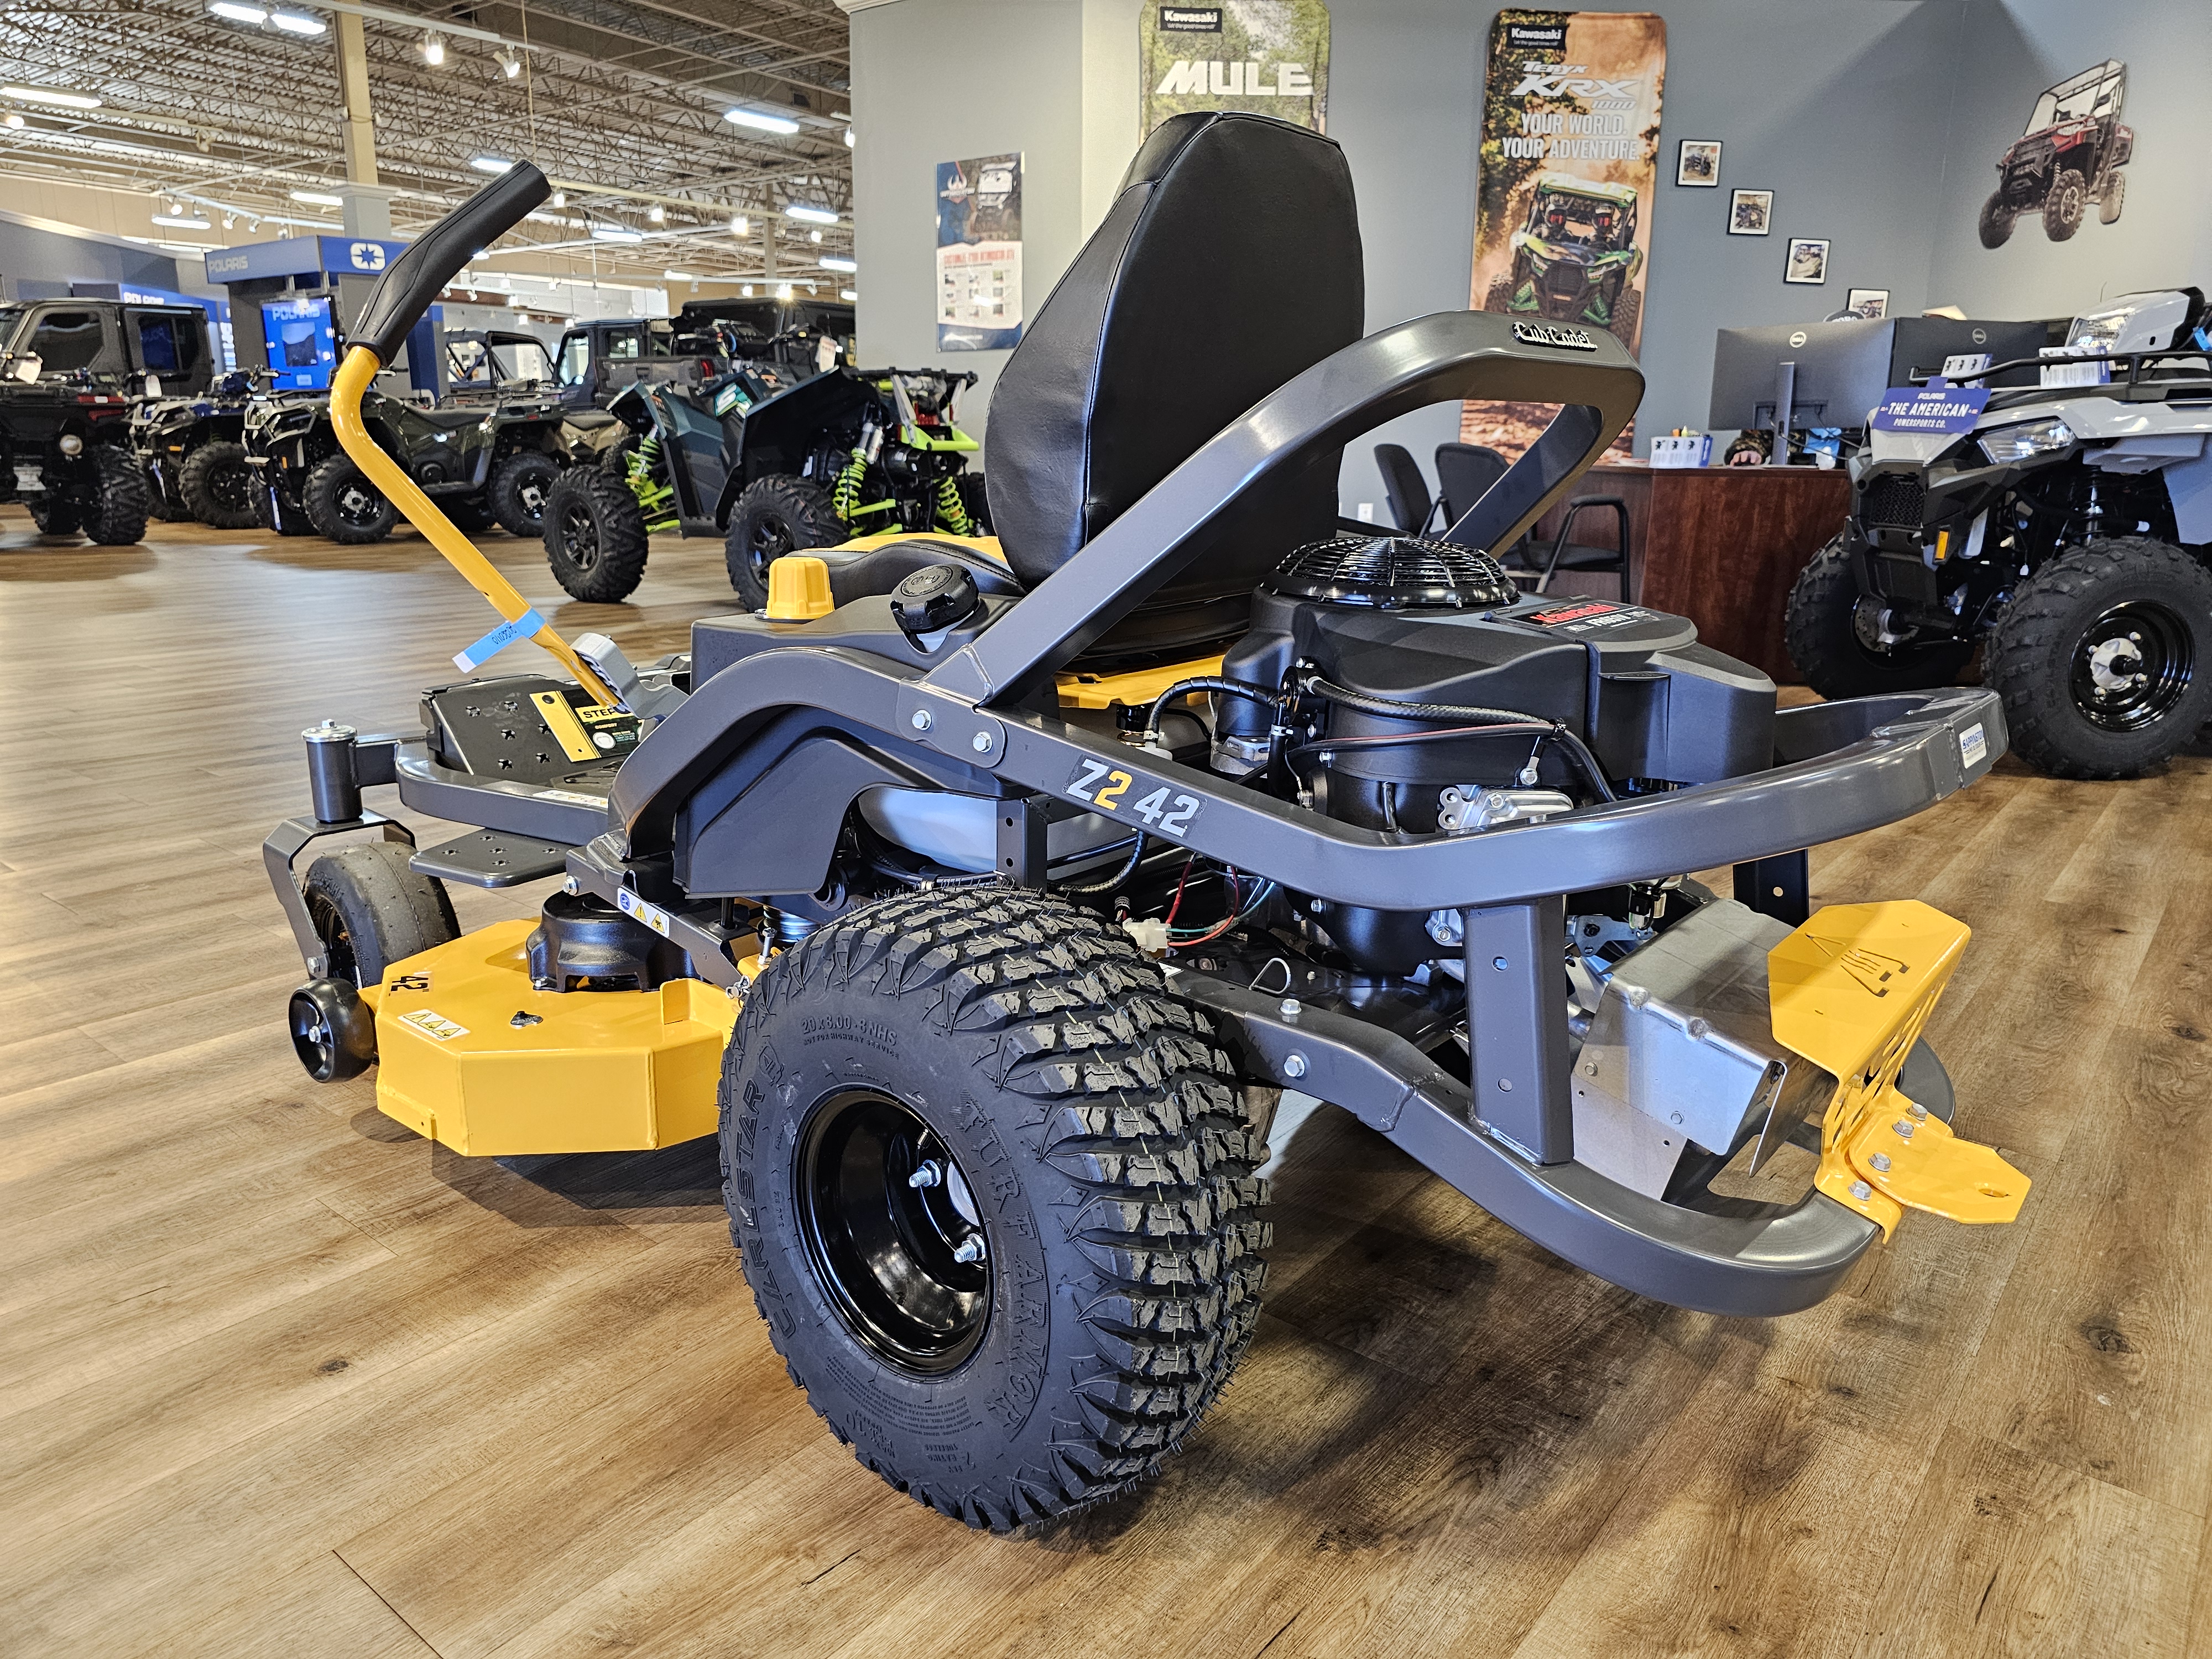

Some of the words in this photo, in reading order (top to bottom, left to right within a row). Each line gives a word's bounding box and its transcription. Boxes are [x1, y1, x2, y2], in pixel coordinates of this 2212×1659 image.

[1164, 10, 1218, 23] Kawasaki
[1511, 28, 1562, 39] Kawasaki
[1156, 61, 1314, 96] MULE
[1510, 75, 1640, 99] KRX
[1592, 100, 1637, 110] 1000
[1521, 113, 1563, 134] YOUR
[1569, 115, 1627, 135] WORLD.
[1503, 137, 1544, 158] YOUR
[1548, 139, 1640, 160] ADVENTURE.
[207, 255, 248, 274] POLARIS
[1515, 321, 1550, 343] Cub
[1547, 326, 1597, 349] Cadet
[1917, 392, 1947, 400] POLARIS
[1887, 402, 1910, 415] THE
[1908, 403, 1970, 418] AMERICAN
[1893, 418, 1936, 428] POWERSPORTS
[1936, 419, 1946, 429] CO.
[1530, 603, 1620, 624] Kawasaki
[1065, 758, 1133, 811] Z2
[1133, 786, 1200, 837] 42
[869, 1021, 898, 1046] NHS
[831, 1032, 864, 1044] HIGHWAY
[866, 1039, 900, 1060] SERVICE
[736, 1078, 796, 1339] CARLSTAR
